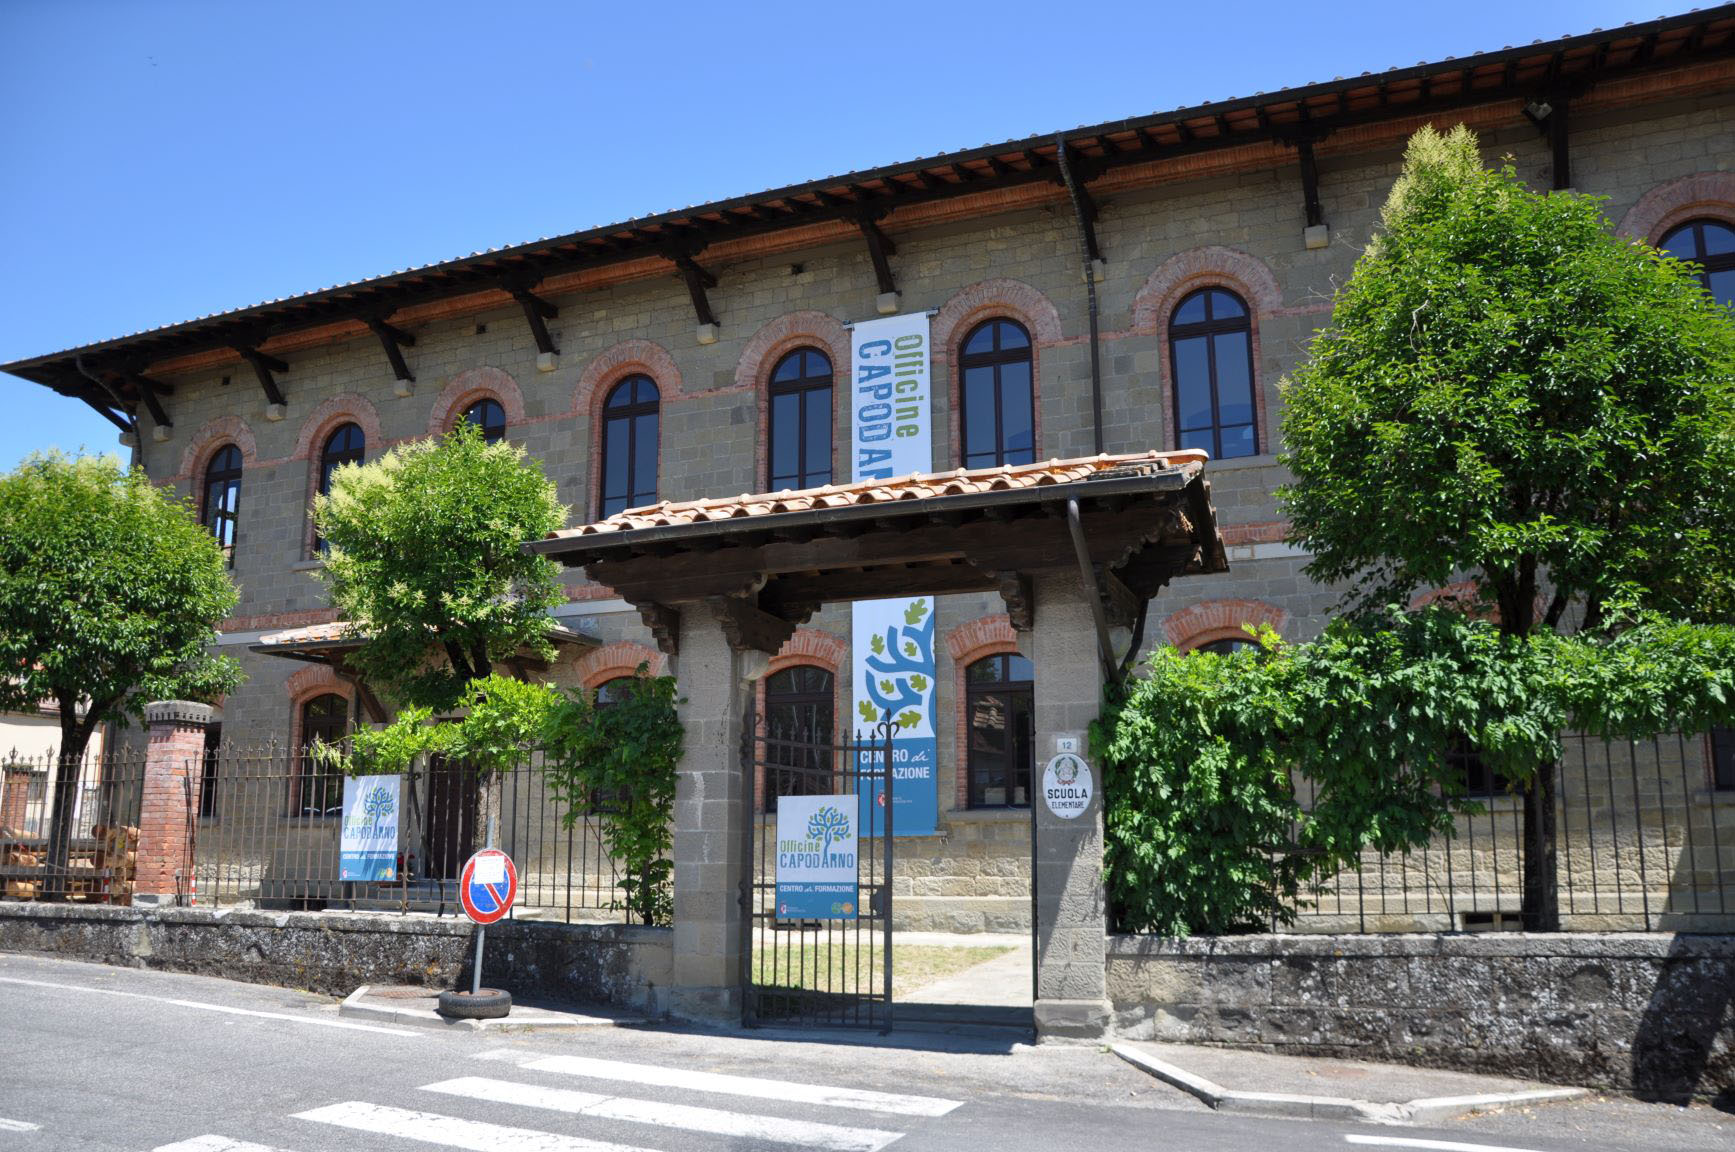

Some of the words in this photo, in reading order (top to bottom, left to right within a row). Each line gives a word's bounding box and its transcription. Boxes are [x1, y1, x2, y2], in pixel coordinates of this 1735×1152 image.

[894, 334, 924, 438] Officine
[860, 749, 909, 764] CENRO
[911, 749, 930, 762] di
[1047, 788, 1088, 799] SCUOLA
[1051, 801, 1085, 809] ELEMENTARE
[780, 840, 820, 853] Officine
[780, 853, 854, 868] CAPODARNO
[779, 885, 803, 893] CENTRO
[815, 885, 854, 893] FORMAZIONE
